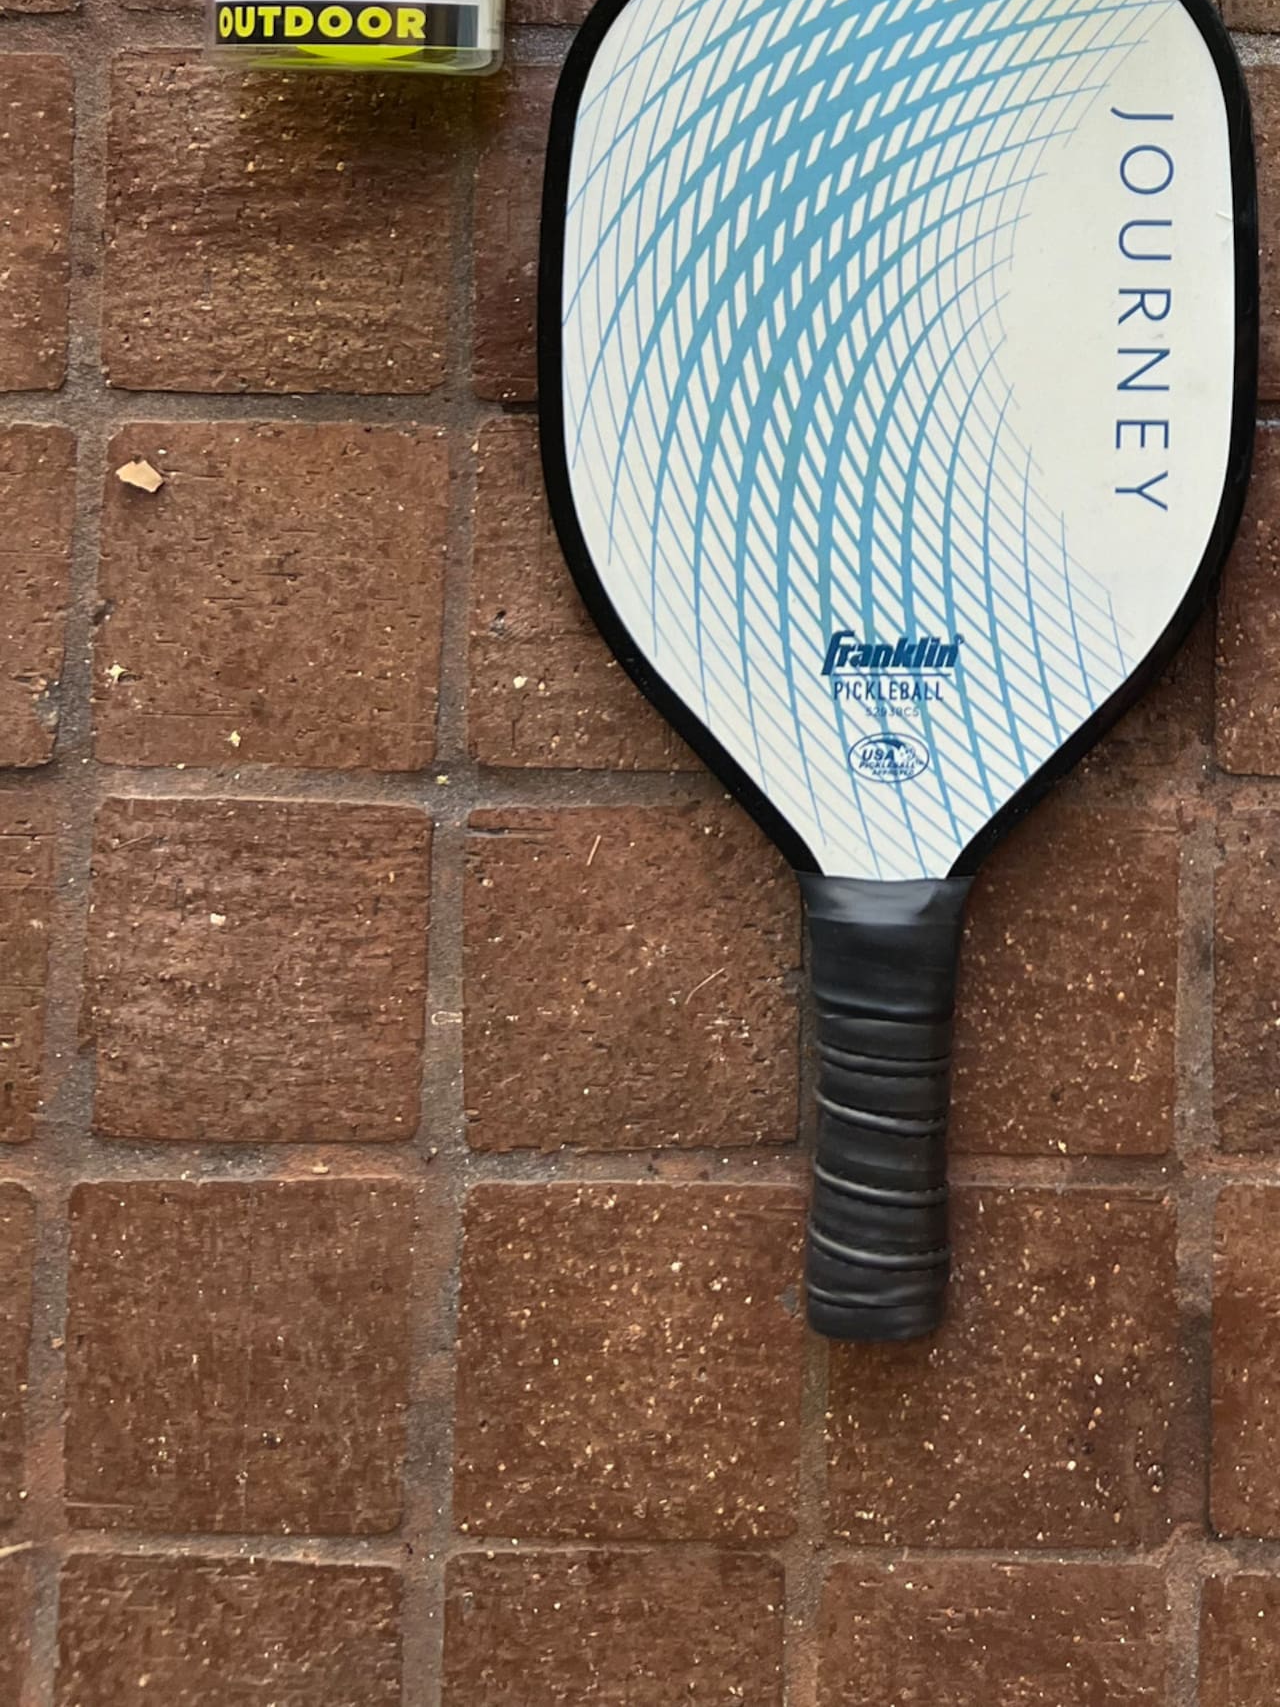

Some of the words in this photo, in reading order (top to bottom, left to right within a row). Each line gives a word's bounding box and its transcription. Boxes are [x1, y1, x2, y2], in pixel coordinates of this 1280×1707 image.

[219, 5, 427, 39] OUTDOOR
[1110, 106, 1174, 511] JOURNEY
[834, 681, 943, 701] PICKLEBALL
[862, 749, 895, 761] USA
